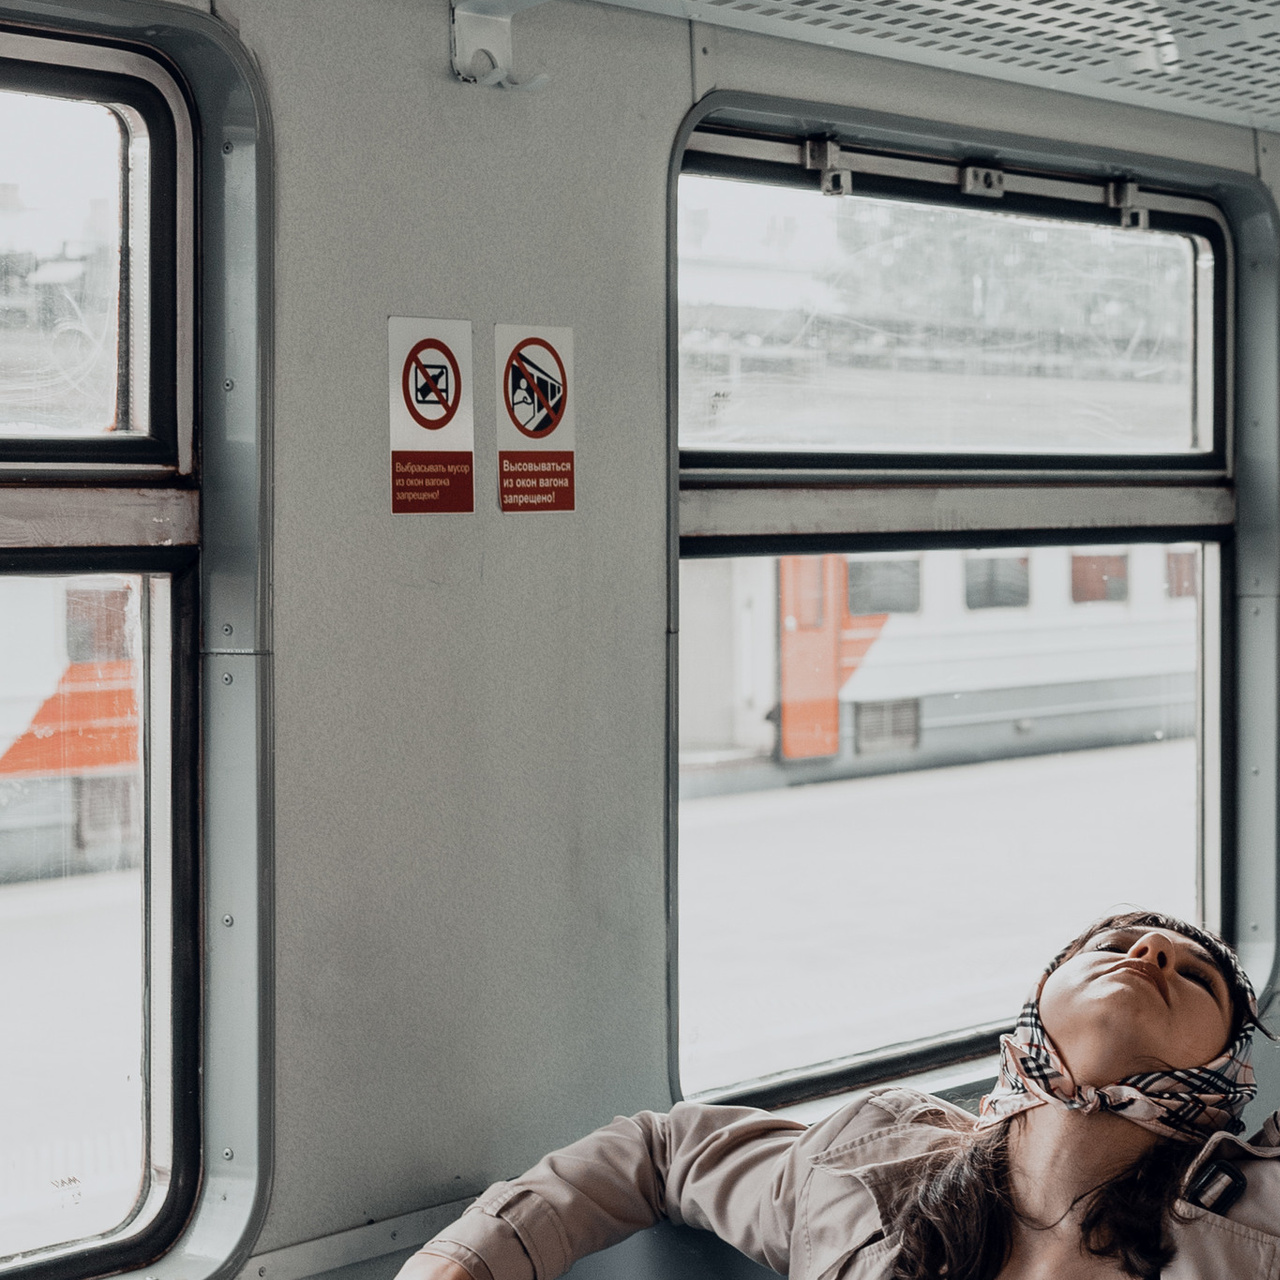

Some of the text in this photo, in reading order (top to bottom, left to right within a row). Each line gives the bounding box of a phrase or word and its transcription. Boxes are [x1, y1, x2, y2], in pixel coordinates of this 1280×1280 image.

[395, 462, 470, 475] Выбрасывать мусор
[503, 459, 571, 472] Высовываться
[395, 478, 450, 487] из окон вагона
[503, 478, 569, 488] из окон вагона
[396, 490, 440, 502] запрещено!
[503, 491, 555, 506] запрещено!
